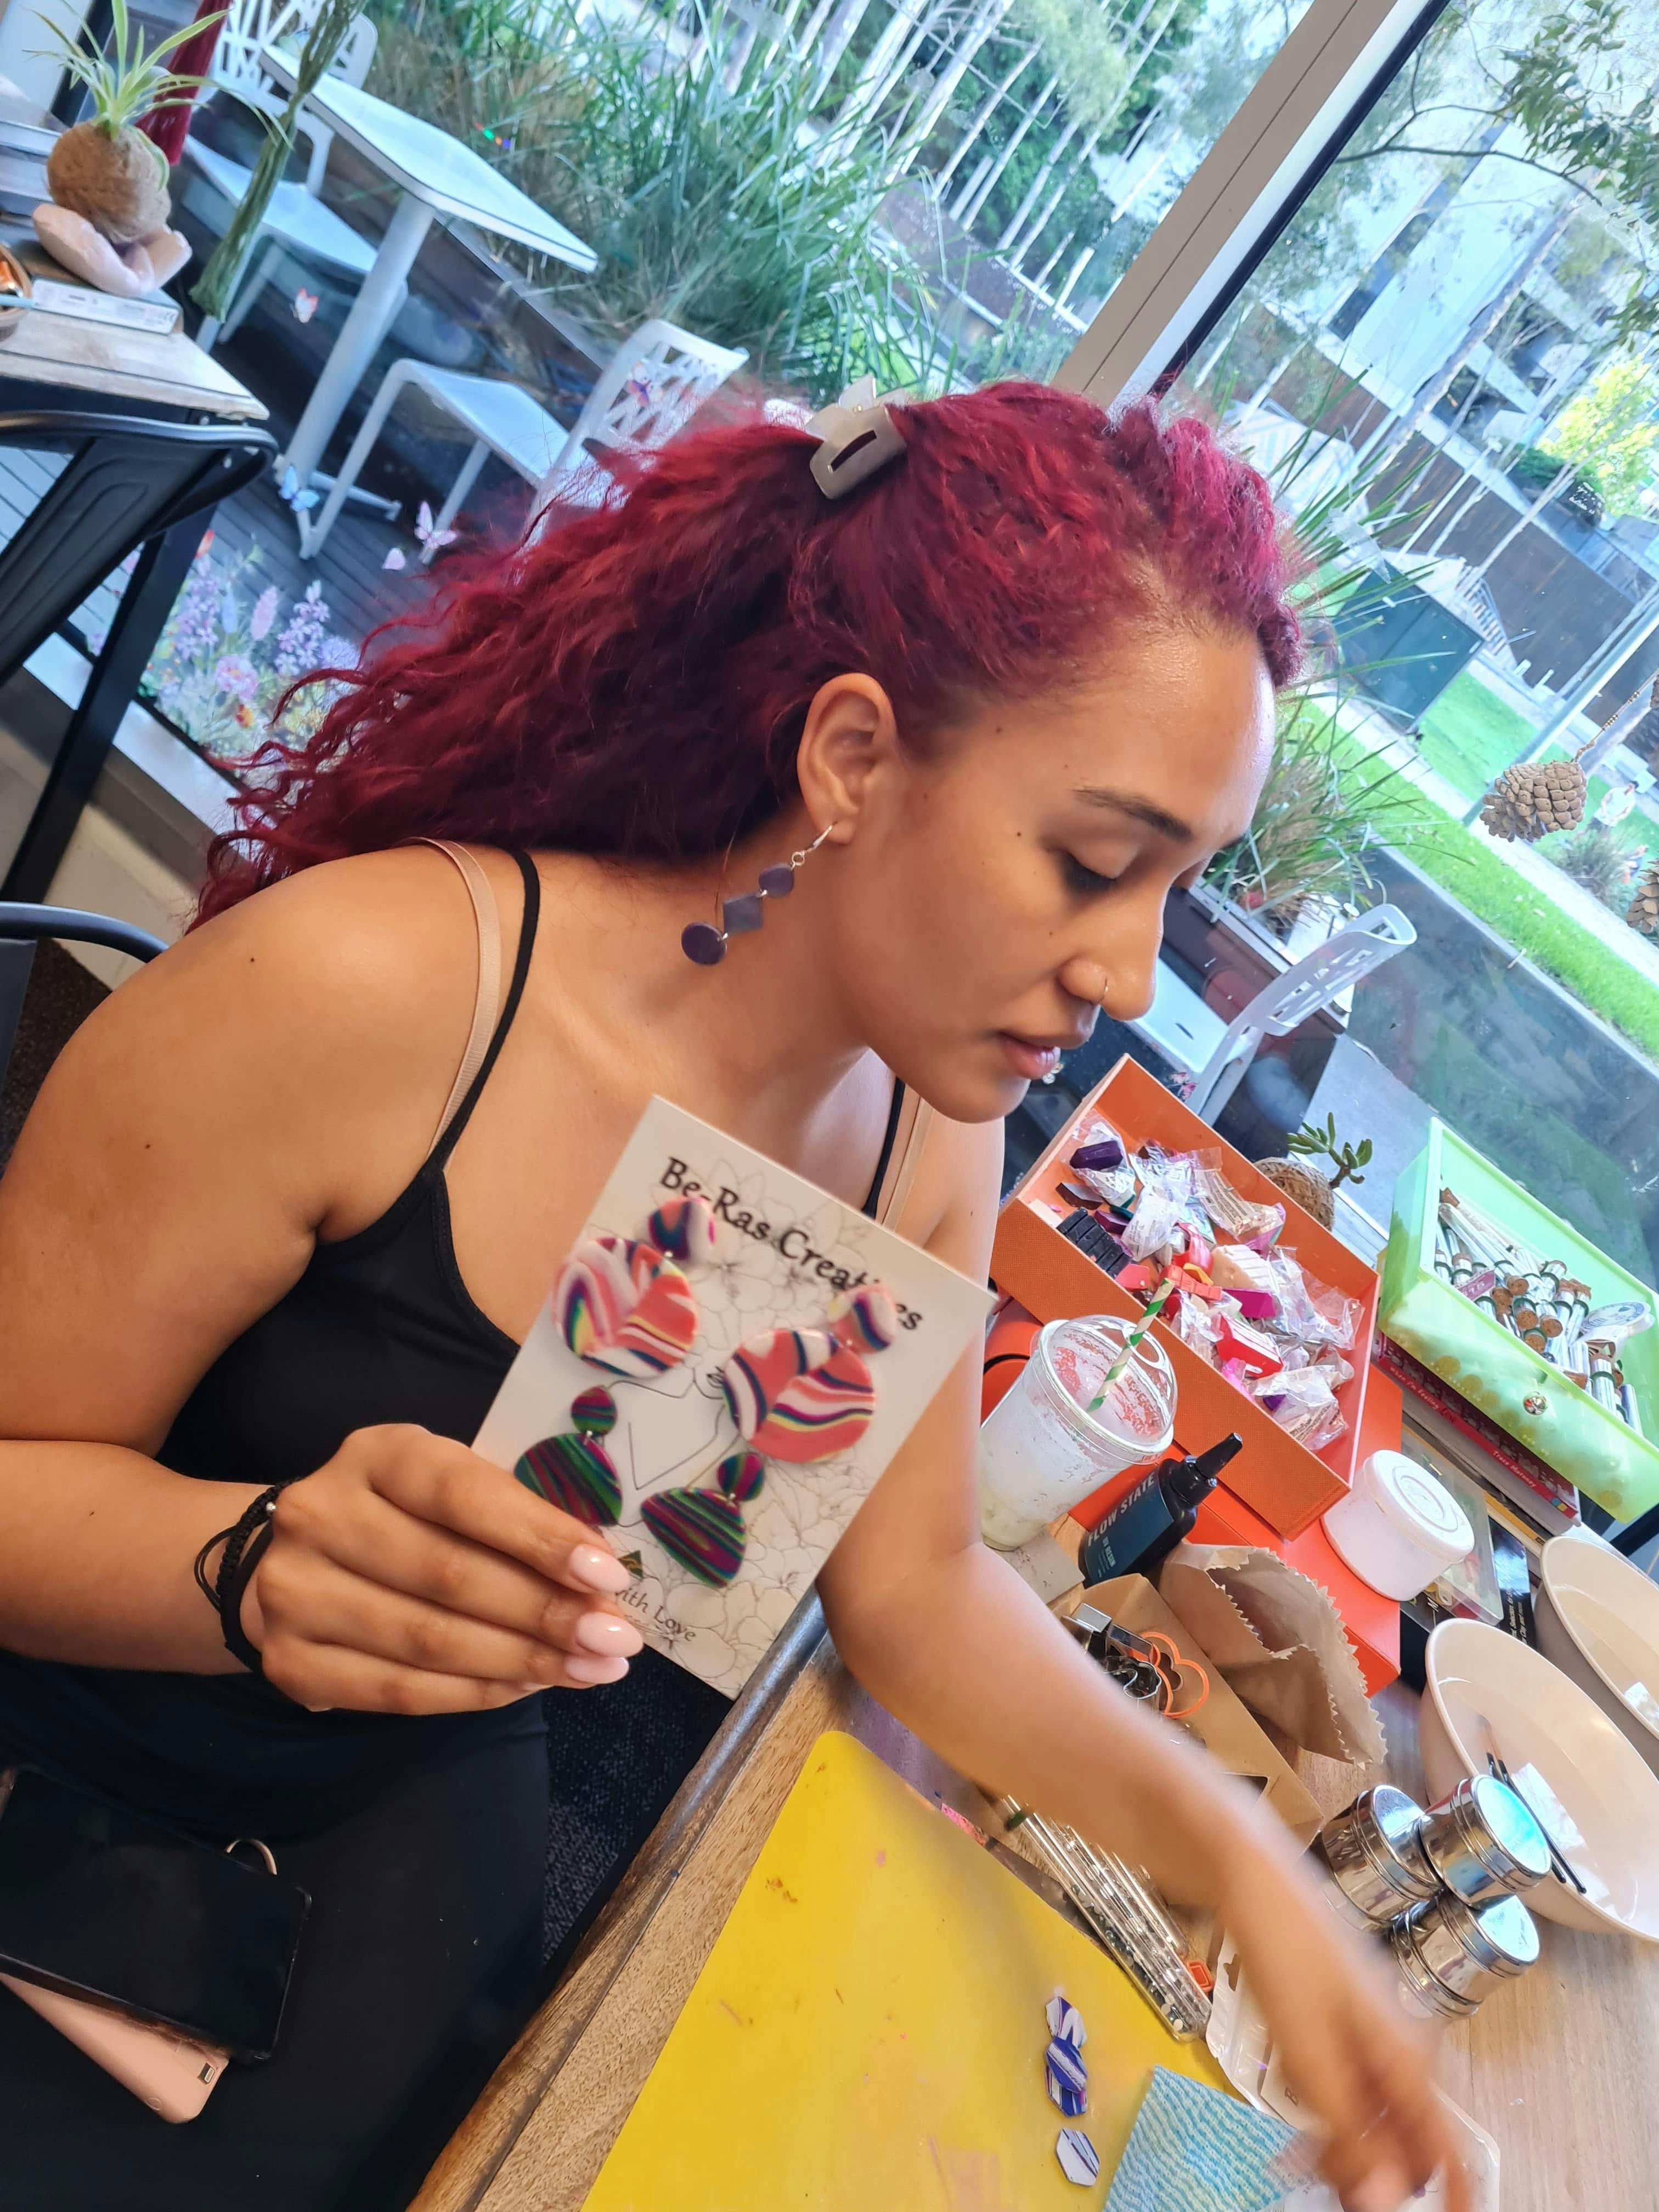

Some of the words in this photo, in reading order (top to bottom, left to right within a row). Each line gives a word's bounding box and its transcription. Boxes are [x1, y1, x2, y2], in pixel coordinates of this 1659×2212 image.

[778, 1228, 923, 1330] Creates
[1087, 1508, 1118, 1548] FLOW
[1120, 1471, 1155, 1514] STATE
[653, 1605, 696, 1642] Love
